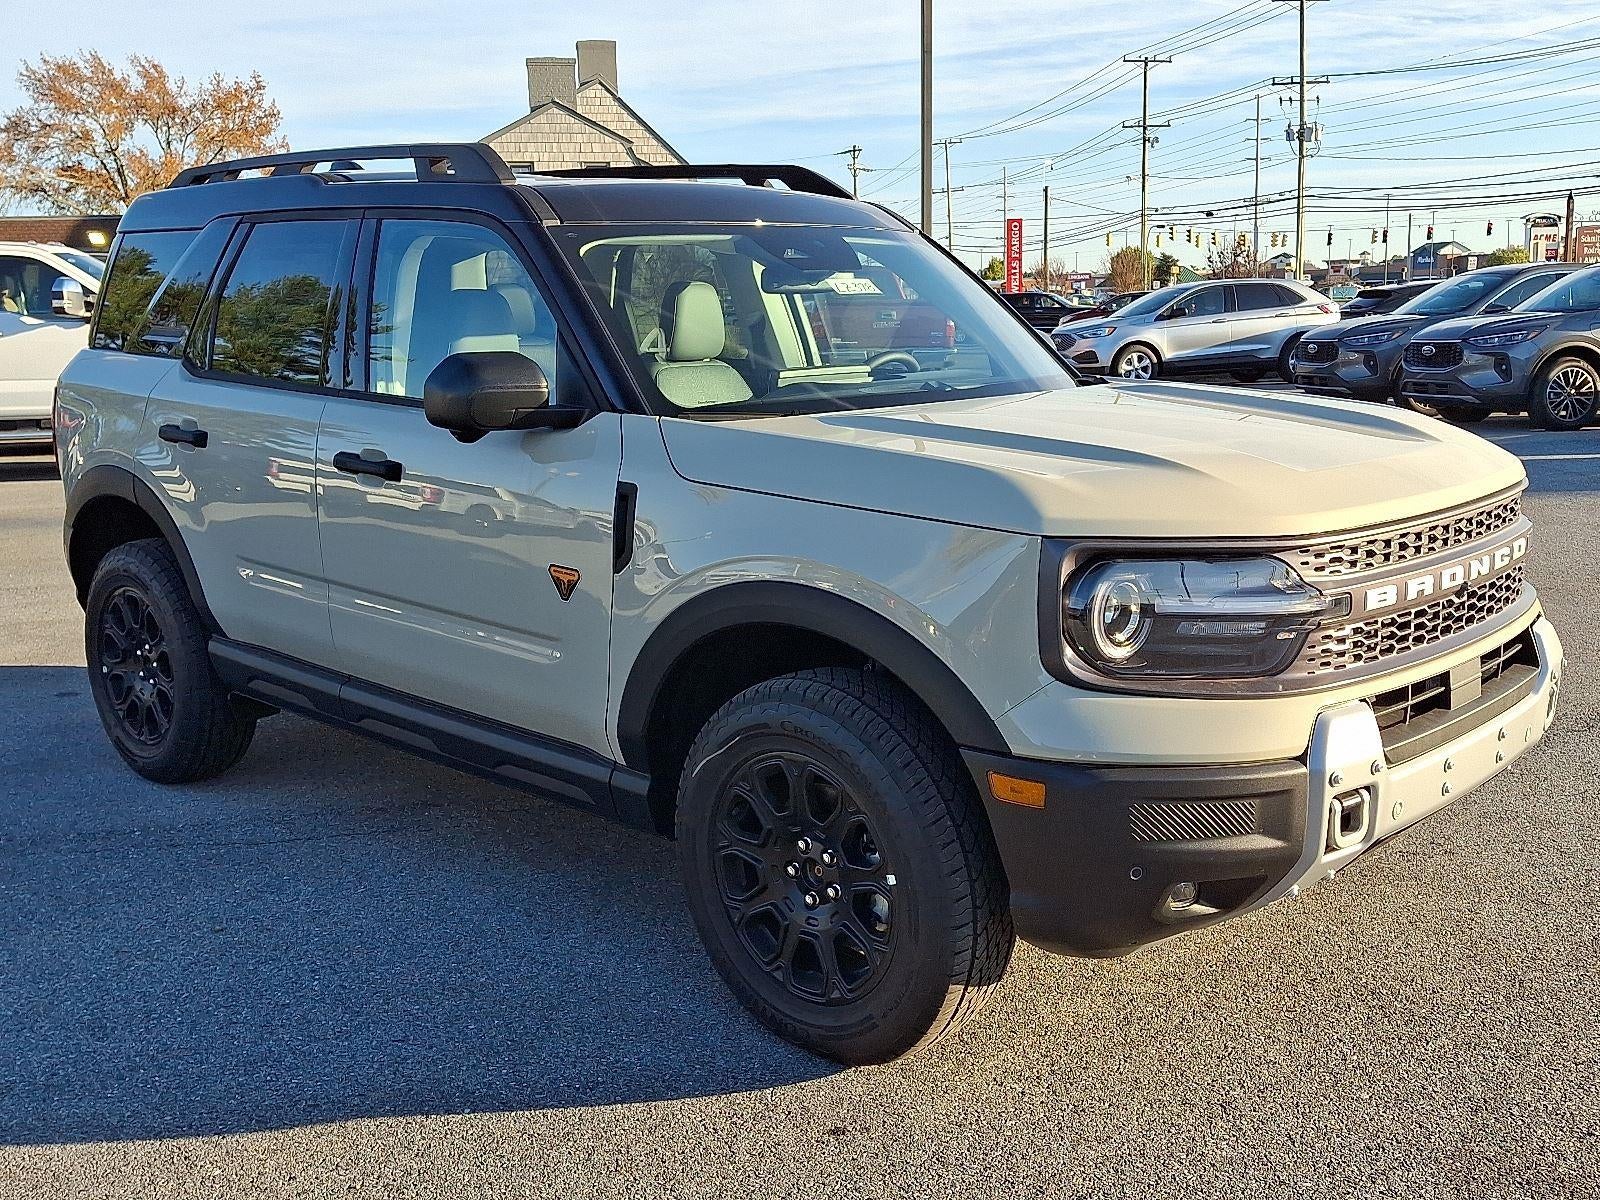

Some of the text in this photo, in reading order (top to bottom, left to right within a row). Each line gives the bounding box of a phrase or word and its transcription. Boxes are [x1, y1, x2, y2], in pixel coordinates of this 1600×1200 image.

[1011, 221, 1020, 293] WELLS FARGO
[1363, 537, 1529, 612] BRONCO
